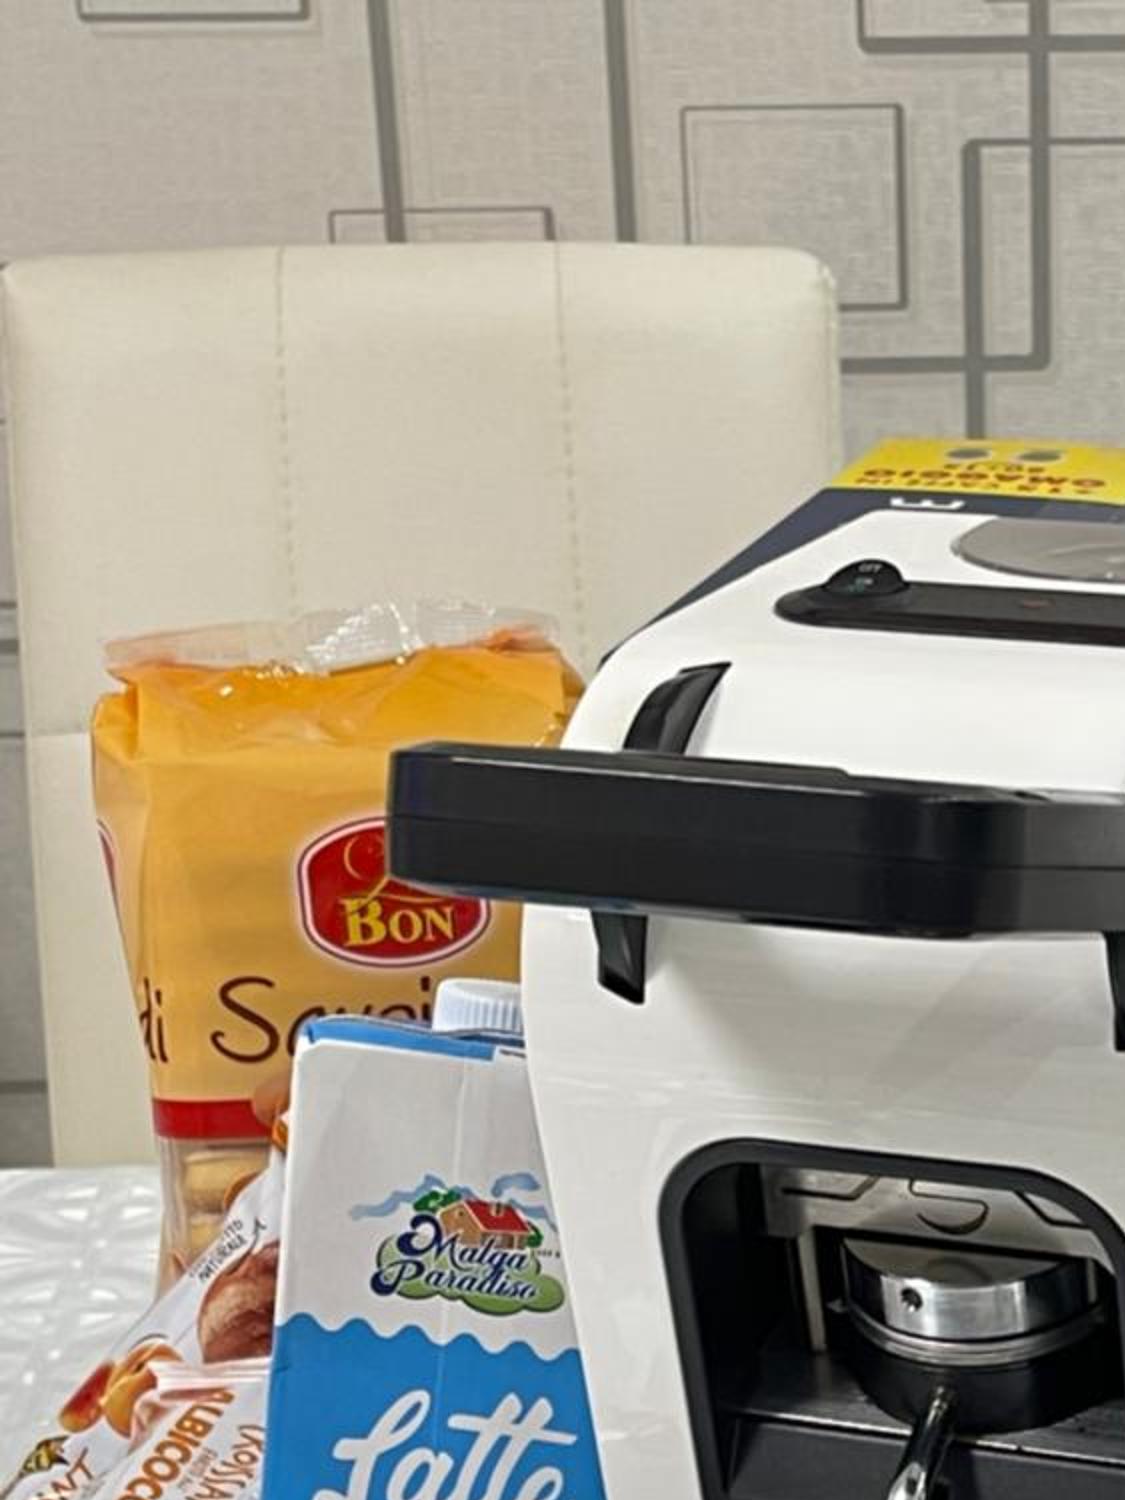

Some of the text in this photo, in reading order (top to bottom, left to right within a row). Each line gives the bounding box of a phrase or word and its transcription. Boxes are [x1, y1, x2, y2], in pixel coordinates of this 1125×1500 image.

[341, 896, 456, 948] BON
[397, 1214, 530, 1278] Malga
[371, 1259, 538, 1300] Paradiso
